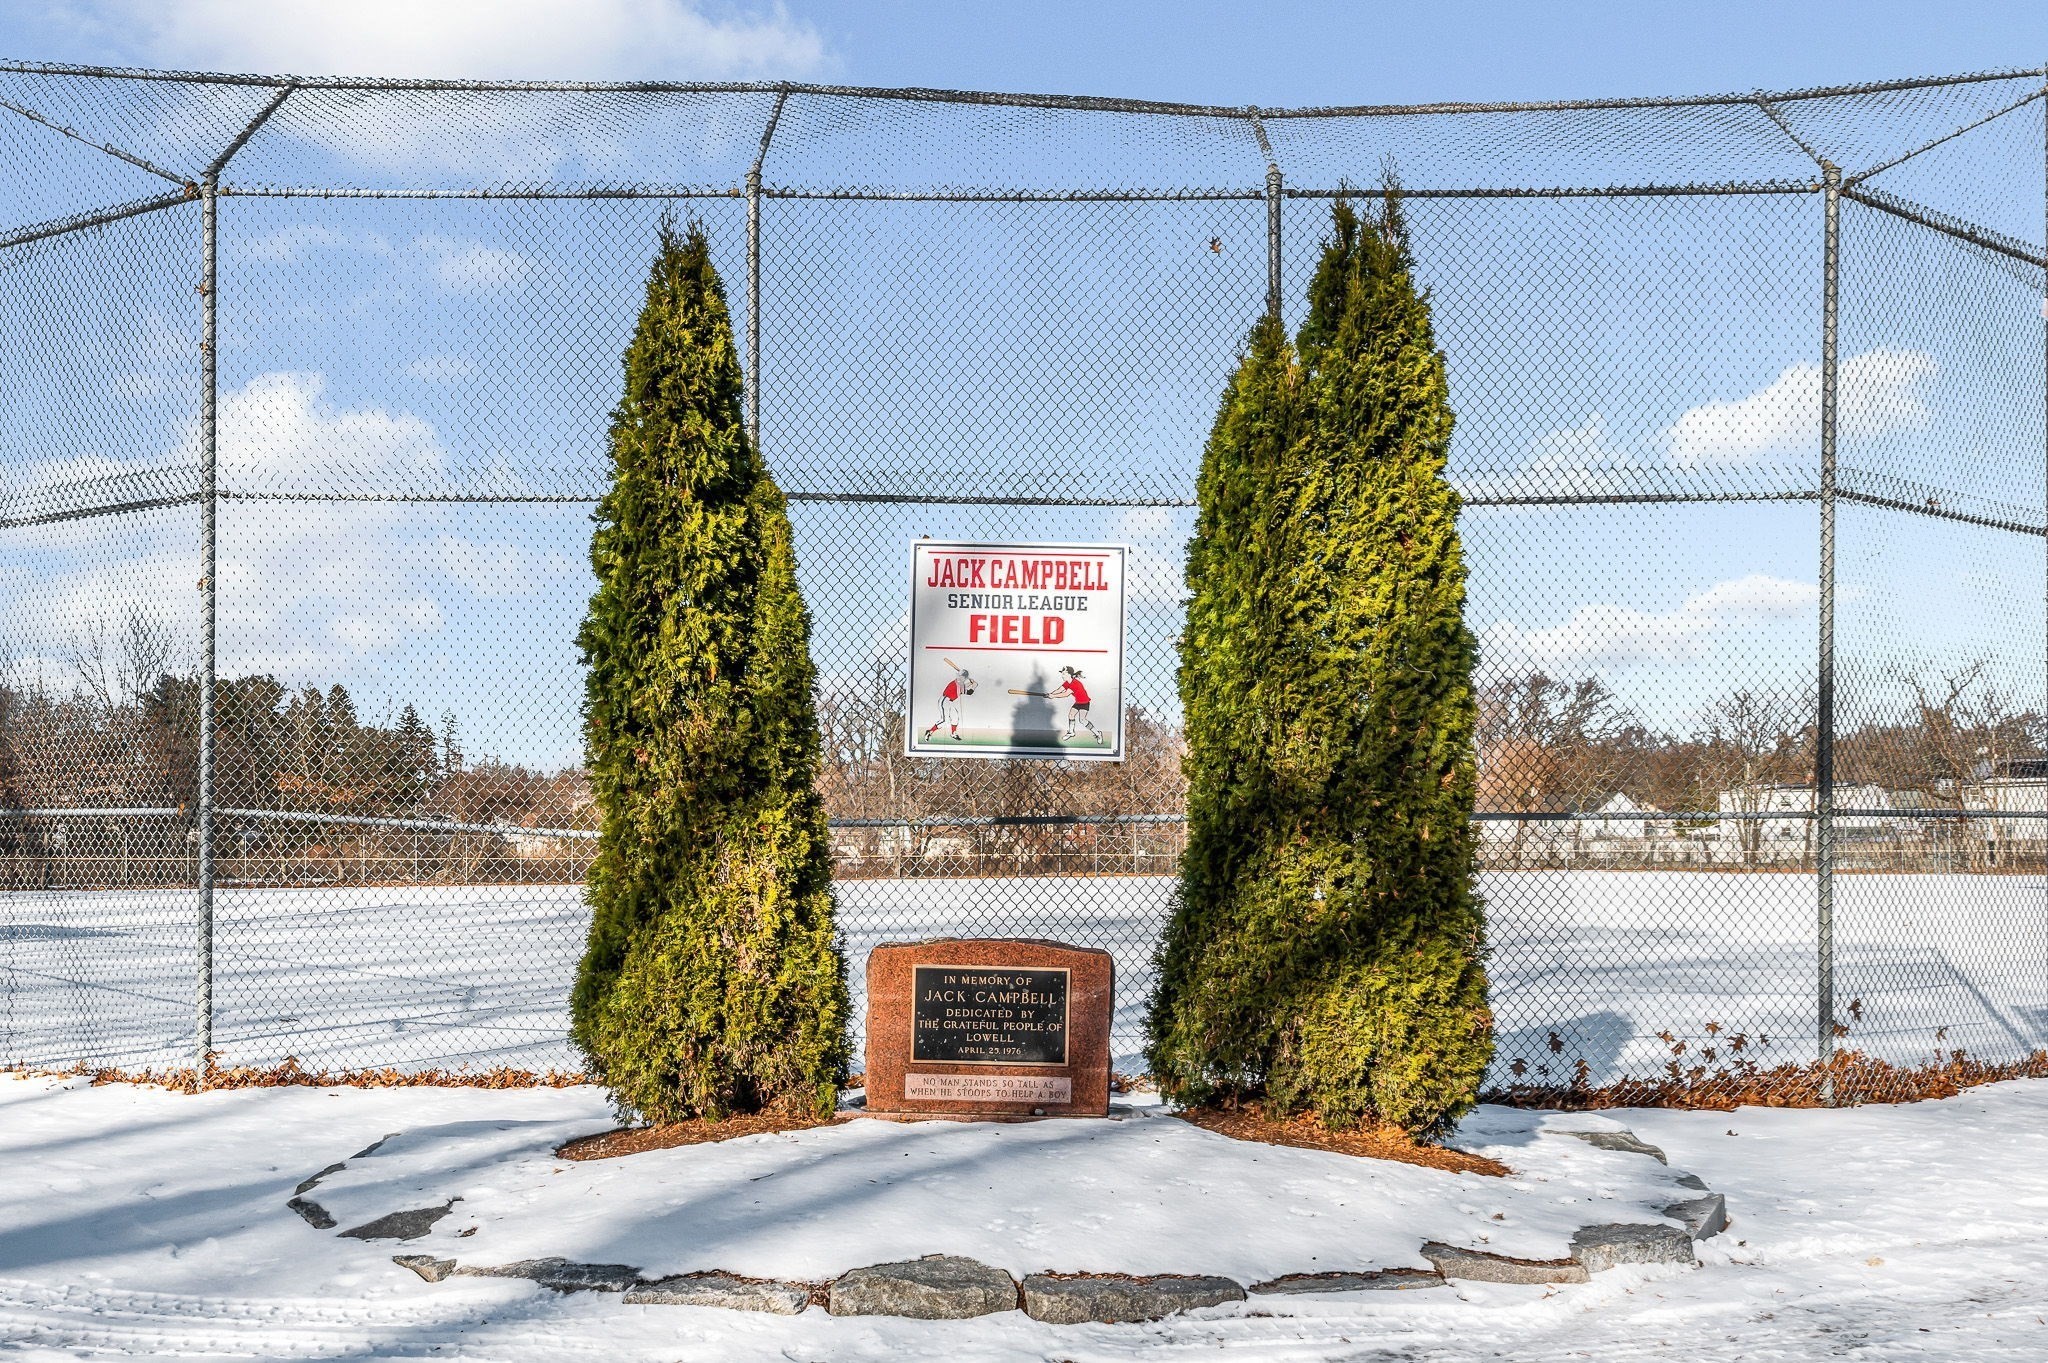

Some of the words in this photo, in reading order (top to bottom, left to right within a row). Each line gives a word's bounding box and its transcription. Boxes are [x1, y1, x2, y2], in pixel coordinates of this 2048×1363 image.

[927, 559, 986, 588] JACK
[991, 559, 1108, 590] CAMPBELL
[948, 594, 1013, 610] SENIOR
[1017, 595, 1088, 611] LEAGUE
[970, 615, 1064, 644] FIELD
[944, 975, 956, 984] IN
[961, 976, 1011, 985] MEMORY
[1016, 977, 1033, 986] OF
[924, 990, 965, 1002] JACK
[975, 991, 1057, 1005] CAMPBELL
[946, 1009, 1012, 1018] DEDICATED
[1021, 1010, 1035, 1018] BY
[918, 1020, 939, 1029] THE
[944, 1021, 999, 1030] GRATEFUL
[1003, 1022, 1043, 1031] PEOPLE
[1049, 1023, 1063, 1031] OF
[966, 1034, 1014, 1043] LOWELL
[923, 1078, 935, 1086] NO
[940, 1078, 959, 1086] MAN
[964, 1079, 997, 1087] STANDS
[910, 1088, 939, 1096] WHEN
[957, 1088, 991, 1097] STOOPS
[1011, 1090, 1034, 1098] HELP
